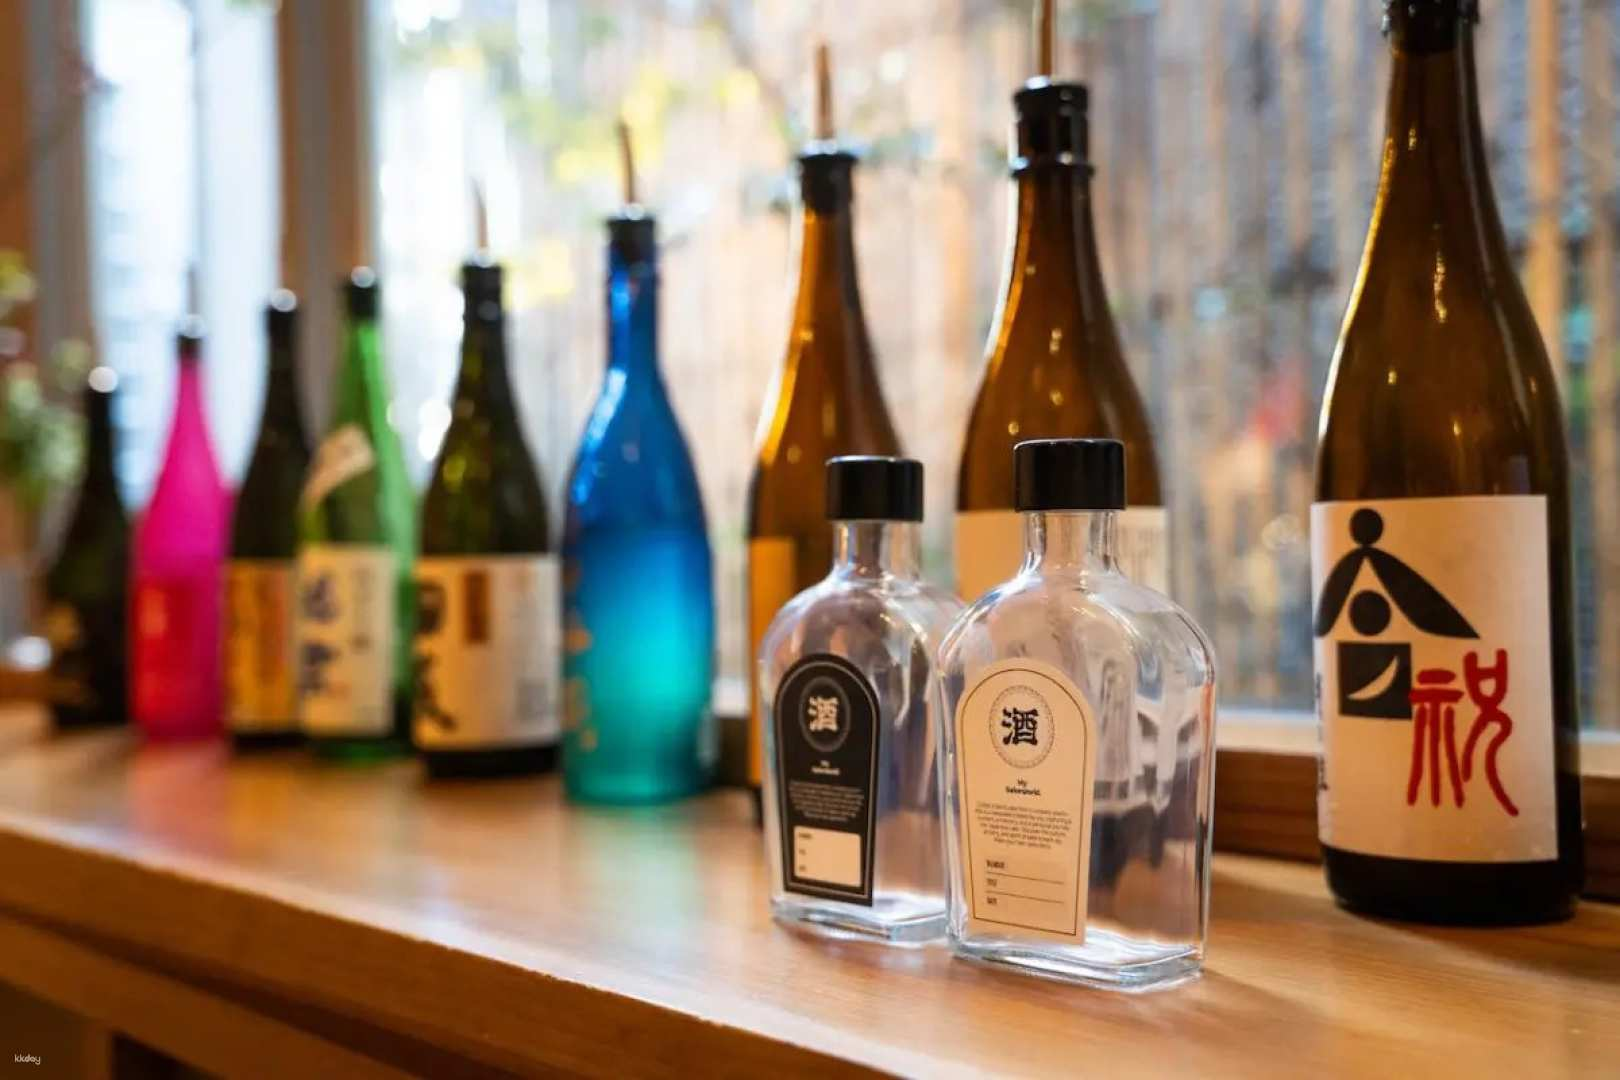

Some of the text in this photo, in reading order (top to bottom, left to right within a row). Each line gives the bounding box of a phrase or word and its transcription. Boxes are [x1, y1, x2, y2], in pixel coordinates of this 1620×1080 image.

[808, 696, 838, 732] 酒
[1001, 707, 1039, 746] 酒
[1407, 648, 1520, 817] 祝
